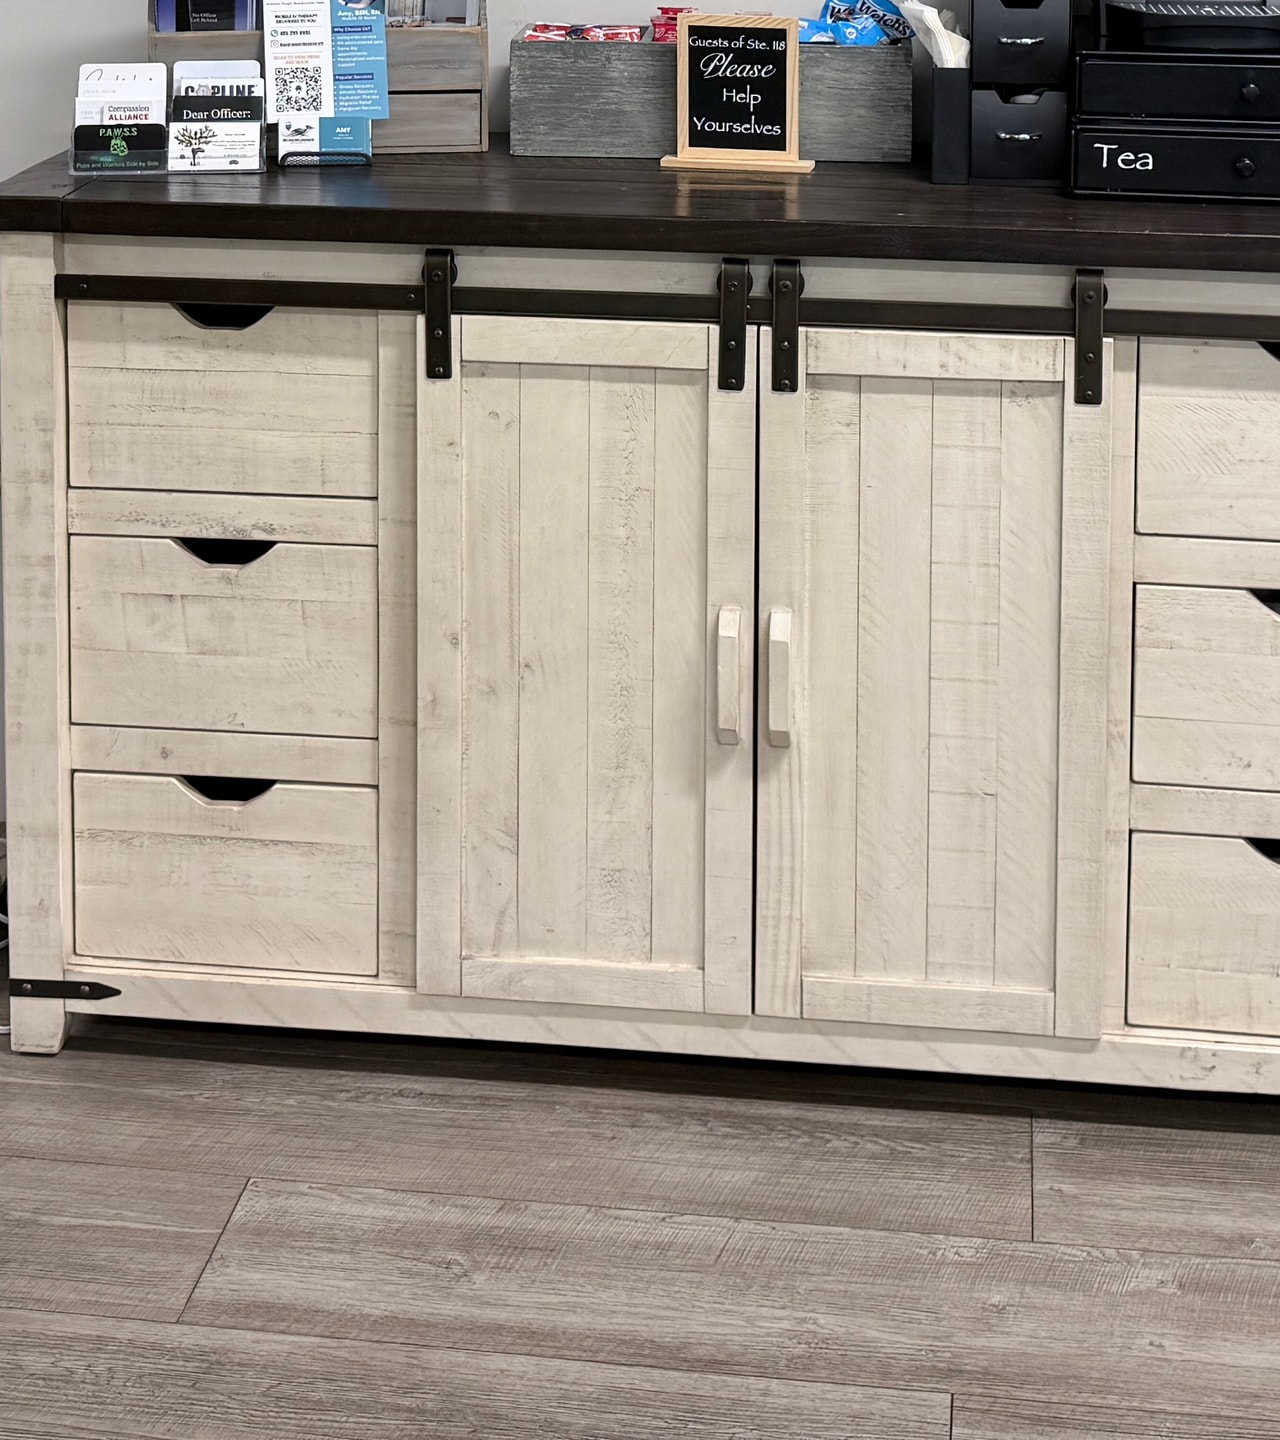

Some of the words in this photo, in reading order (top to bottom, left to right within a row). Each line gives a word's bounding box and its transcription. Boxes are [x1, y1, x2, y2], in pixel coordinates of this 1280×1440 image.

[689, 36, 729, 48] Guests
[731, 35, 745, 49] of
[746, 39, 770, 50] Ste.
[772, 40, 786, 51] 118
[700, 52, 777, 79] Please
[722, 84, 762, 112] Help
[108, 105, 150, 113] Compassion
[183, 109, 209, 120] Dear
[211, 108, 251, 119] Officer:
[693, 115, 781, 136] Yourselves
[1094, 143, 1154, 170] Tea
